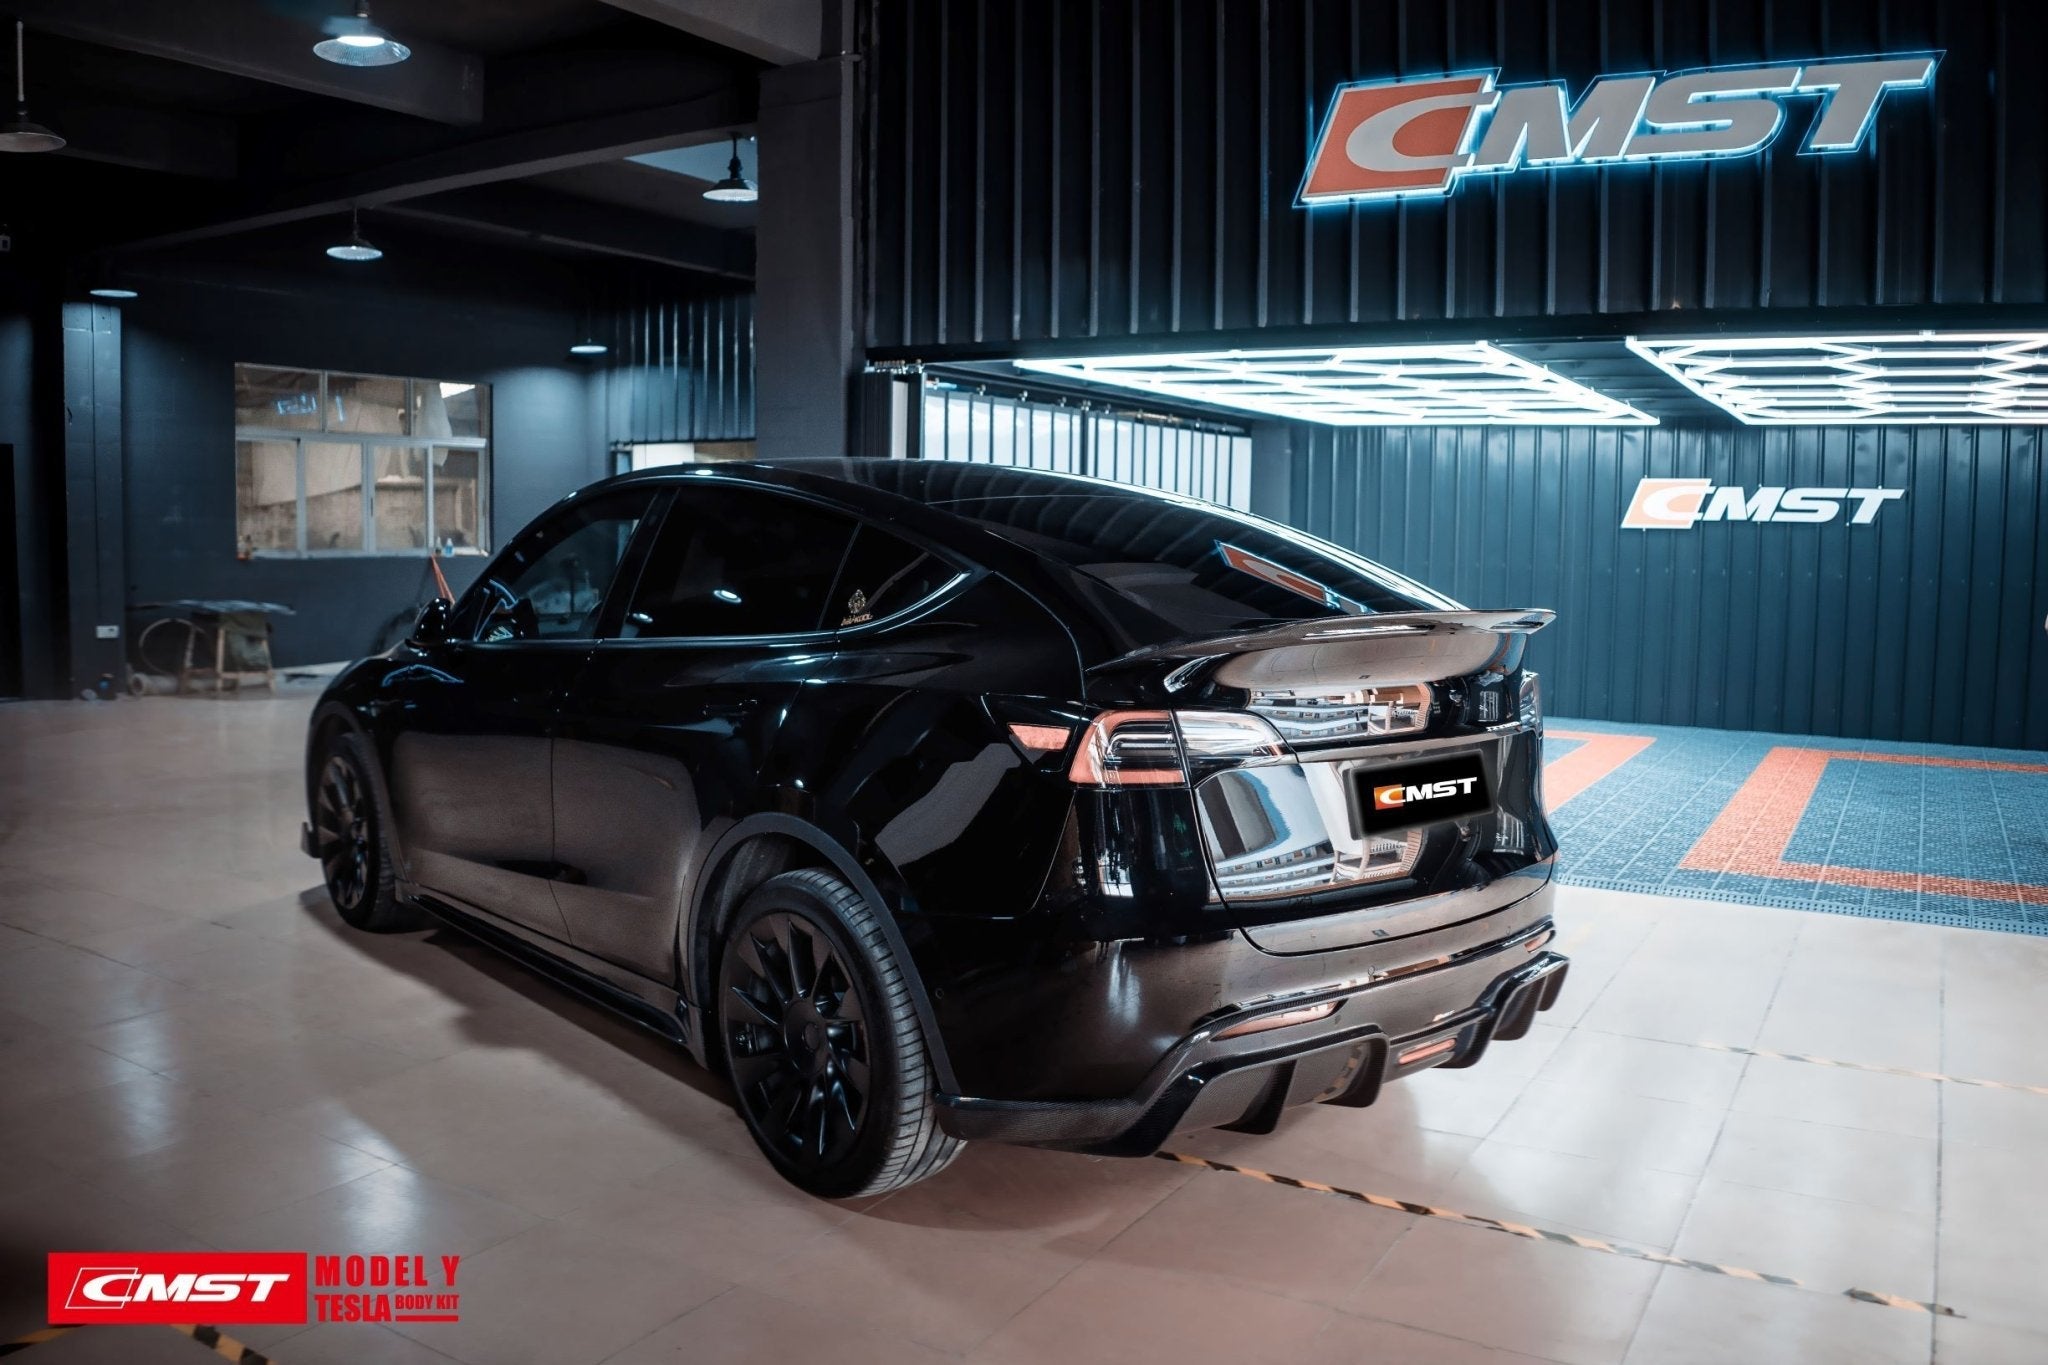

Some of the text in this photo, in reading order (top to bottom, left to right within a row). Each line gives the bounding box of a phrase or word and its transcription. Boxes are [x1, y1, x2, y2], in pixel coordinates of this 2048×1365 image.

[1344, 57, 1937, 173] CMST
[1641, 484, 1906, 525] CMST
[1379, 776, 1478, 805] CMST
